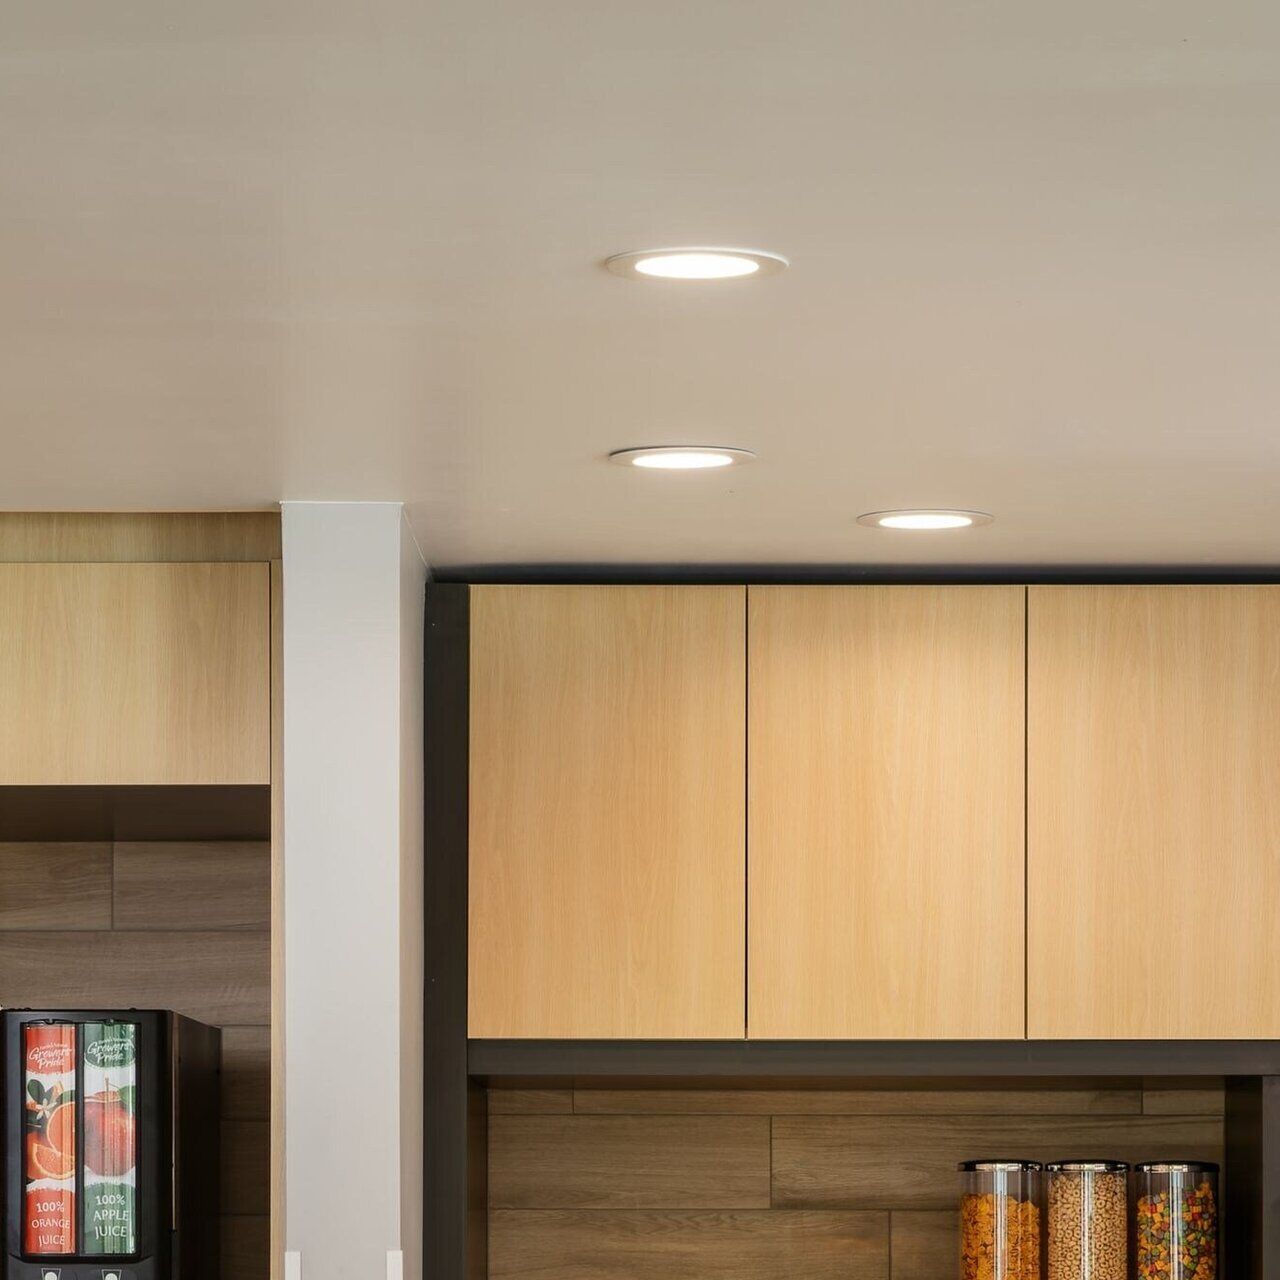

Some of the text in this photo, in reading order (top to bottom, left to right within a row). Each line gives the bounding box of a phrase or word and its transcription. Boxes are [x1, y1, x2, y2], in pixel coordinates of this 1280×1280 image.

[95, 1194, 126, 1206] 100%
[36, 1201, 65, 1213] 100%
[93, 1209, 129, 1222] APPLE
[31, 1218, 71, 1229] ORANGE
[95, 1225, 127, 1240] JUICE
[39, 1235, 66, 1247] JUICE
